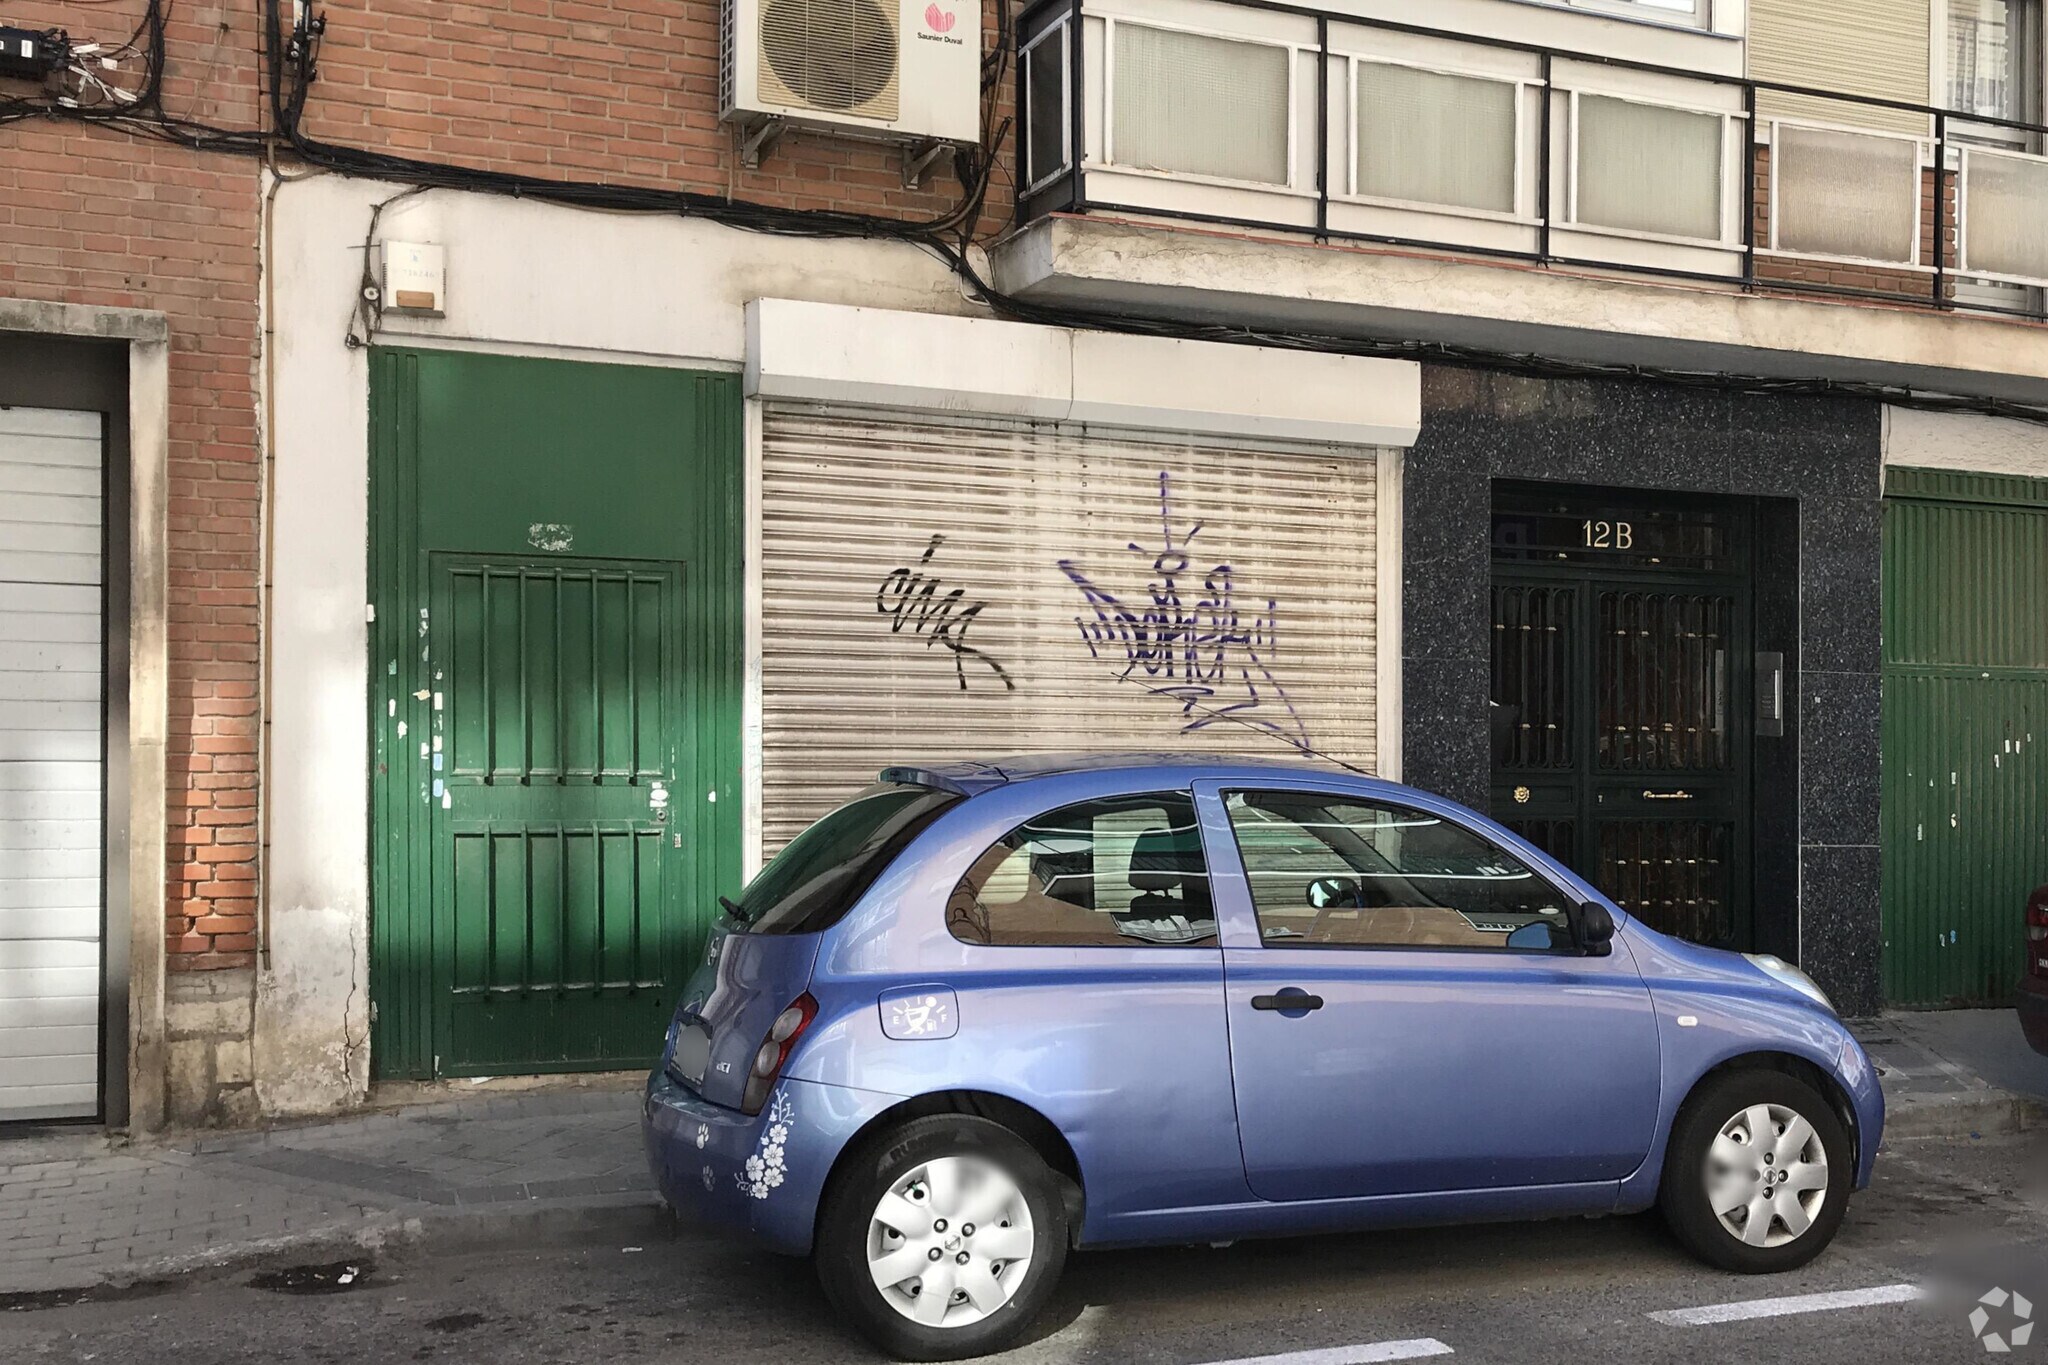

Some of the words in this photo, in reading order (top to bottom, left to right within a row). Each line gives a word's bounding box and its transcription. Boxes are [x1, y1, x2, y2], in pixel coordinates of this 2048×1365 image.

[917, 31, 943, 42] Saunier
[944, 36, 963, 45] Duval
[893, 1015, 900, 1025] E
[941, 1014, 947, 1023] F
